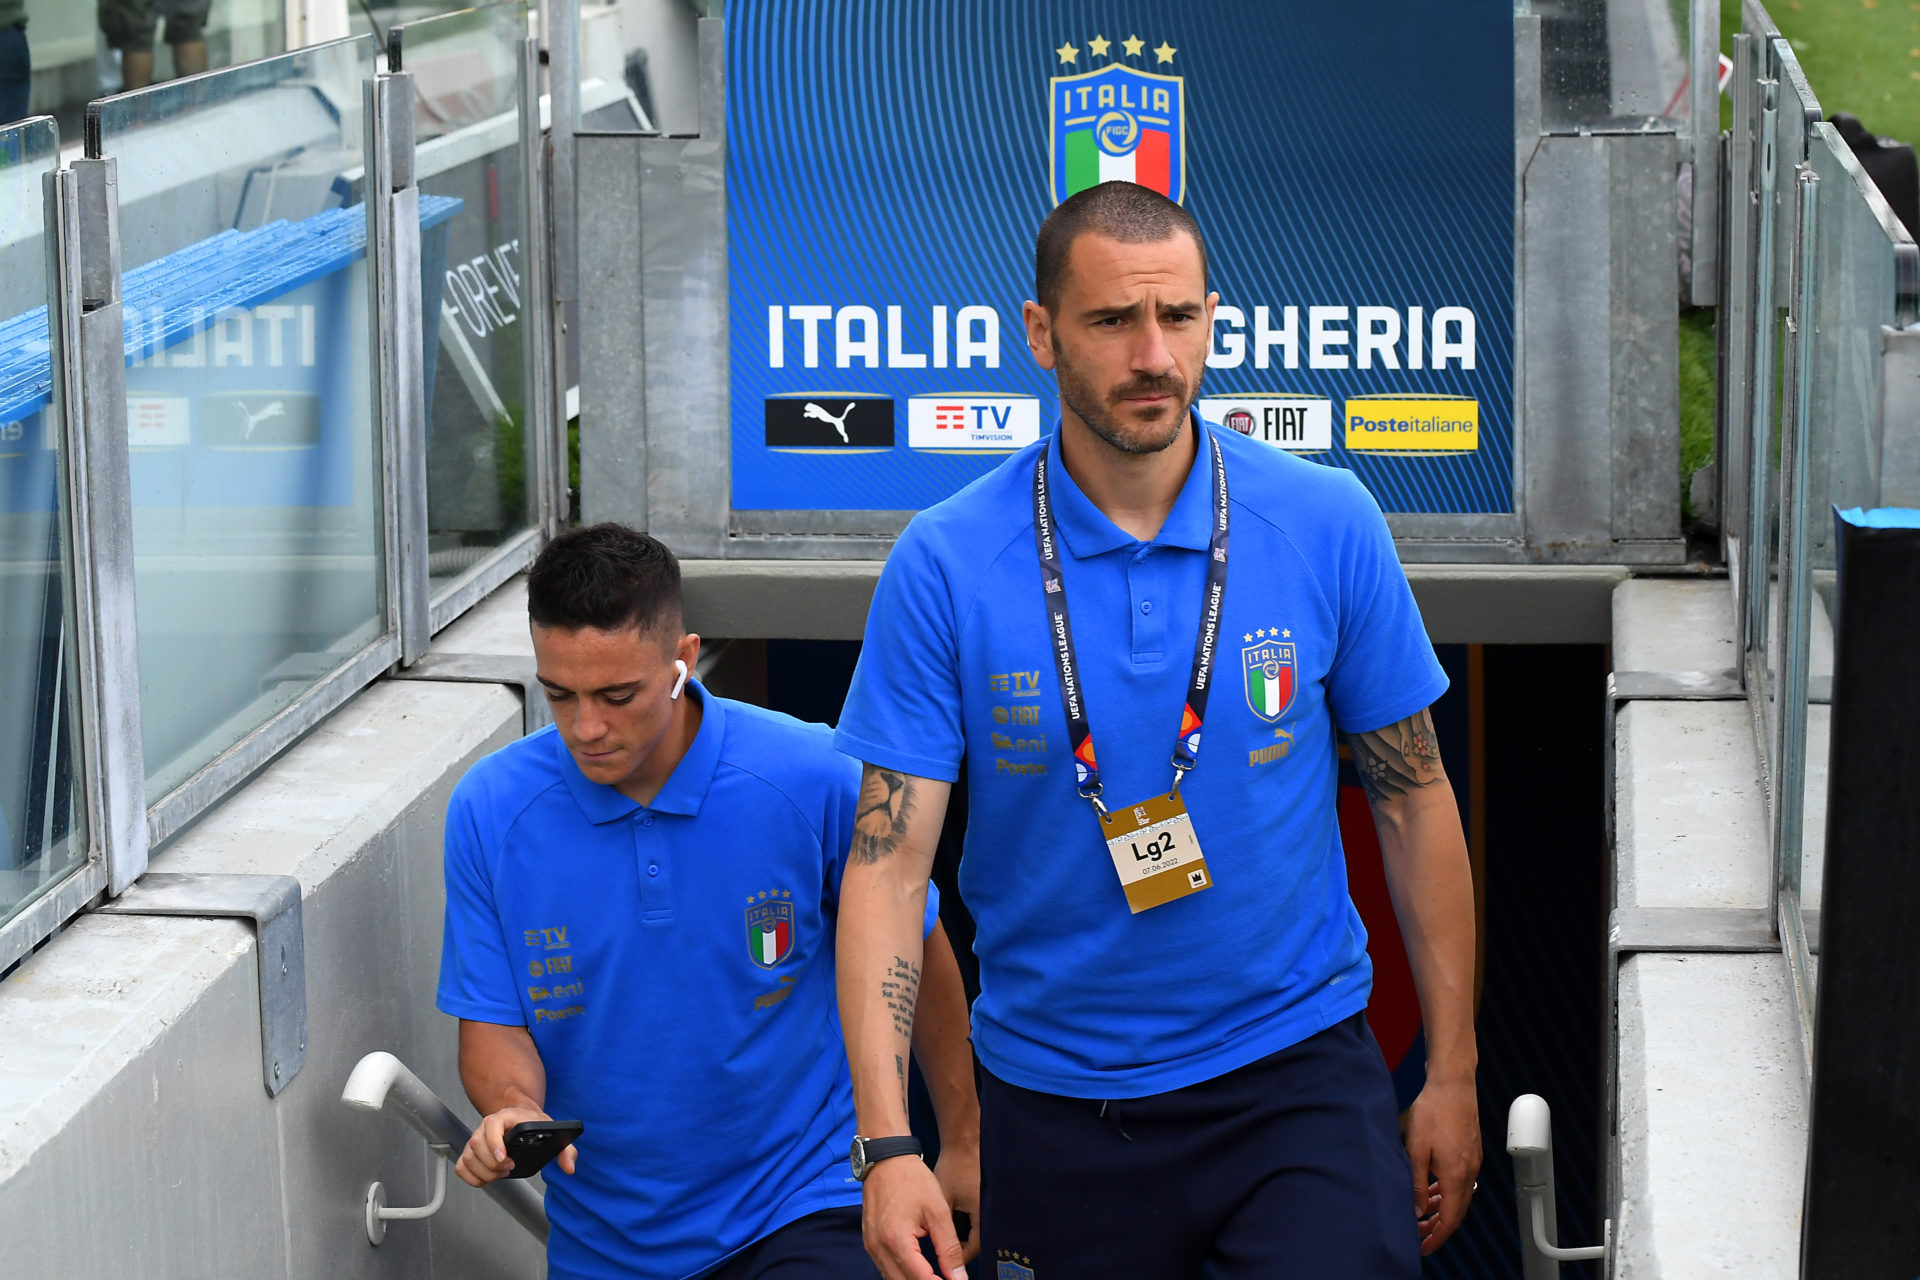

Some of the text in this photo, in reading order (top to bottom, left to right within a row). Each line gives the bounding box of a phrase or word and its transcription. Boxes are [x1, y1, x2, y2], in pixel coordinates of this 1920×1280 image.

[1065, 84, 1169, 113] ITALIA
[1106, 126, 1128, 134] FIGC
[769, 305, 1476, 370] ITALIA GHERIA
[971, 406, 1012, 429] TV
[1264, 408, 1308, 440] FIAT
[1350, 415, 1473, 433] Posteitaliane
[1218, 469, 1227, 508] NATIONS
[1037, 460, 1053, 560] UEFA NATIONS LEAGUE
[1219, 509, 1227, 531] UEFA
[1196, 583, 1222, 690] UEFA NATIONS LEAGUE
[1054, 612, 1080, 720] UEFA NATIONS LEAGUE
[1248, 648, 1292, 664] ITALIA
[1011, 670, 1040, 690] TV
[1011, 706, 1040, 726] FIAT
[1016, 733, 1047, 752] eni
[1249, 740, 1289, 767] PUMA
[996, 758, 1047, 775] Poste
[1131, 831, 1176, 862] Lg2
[1142, 857, 1179, 876] 07.06.2022
[750, 906, 788, 922] ITALIA
[540, 926, 567, 944] TV
[545, 955, 573, 975] FIAT
[553, 977, 584, 998] eni
[534, 1005, 585, 1023] Poste
